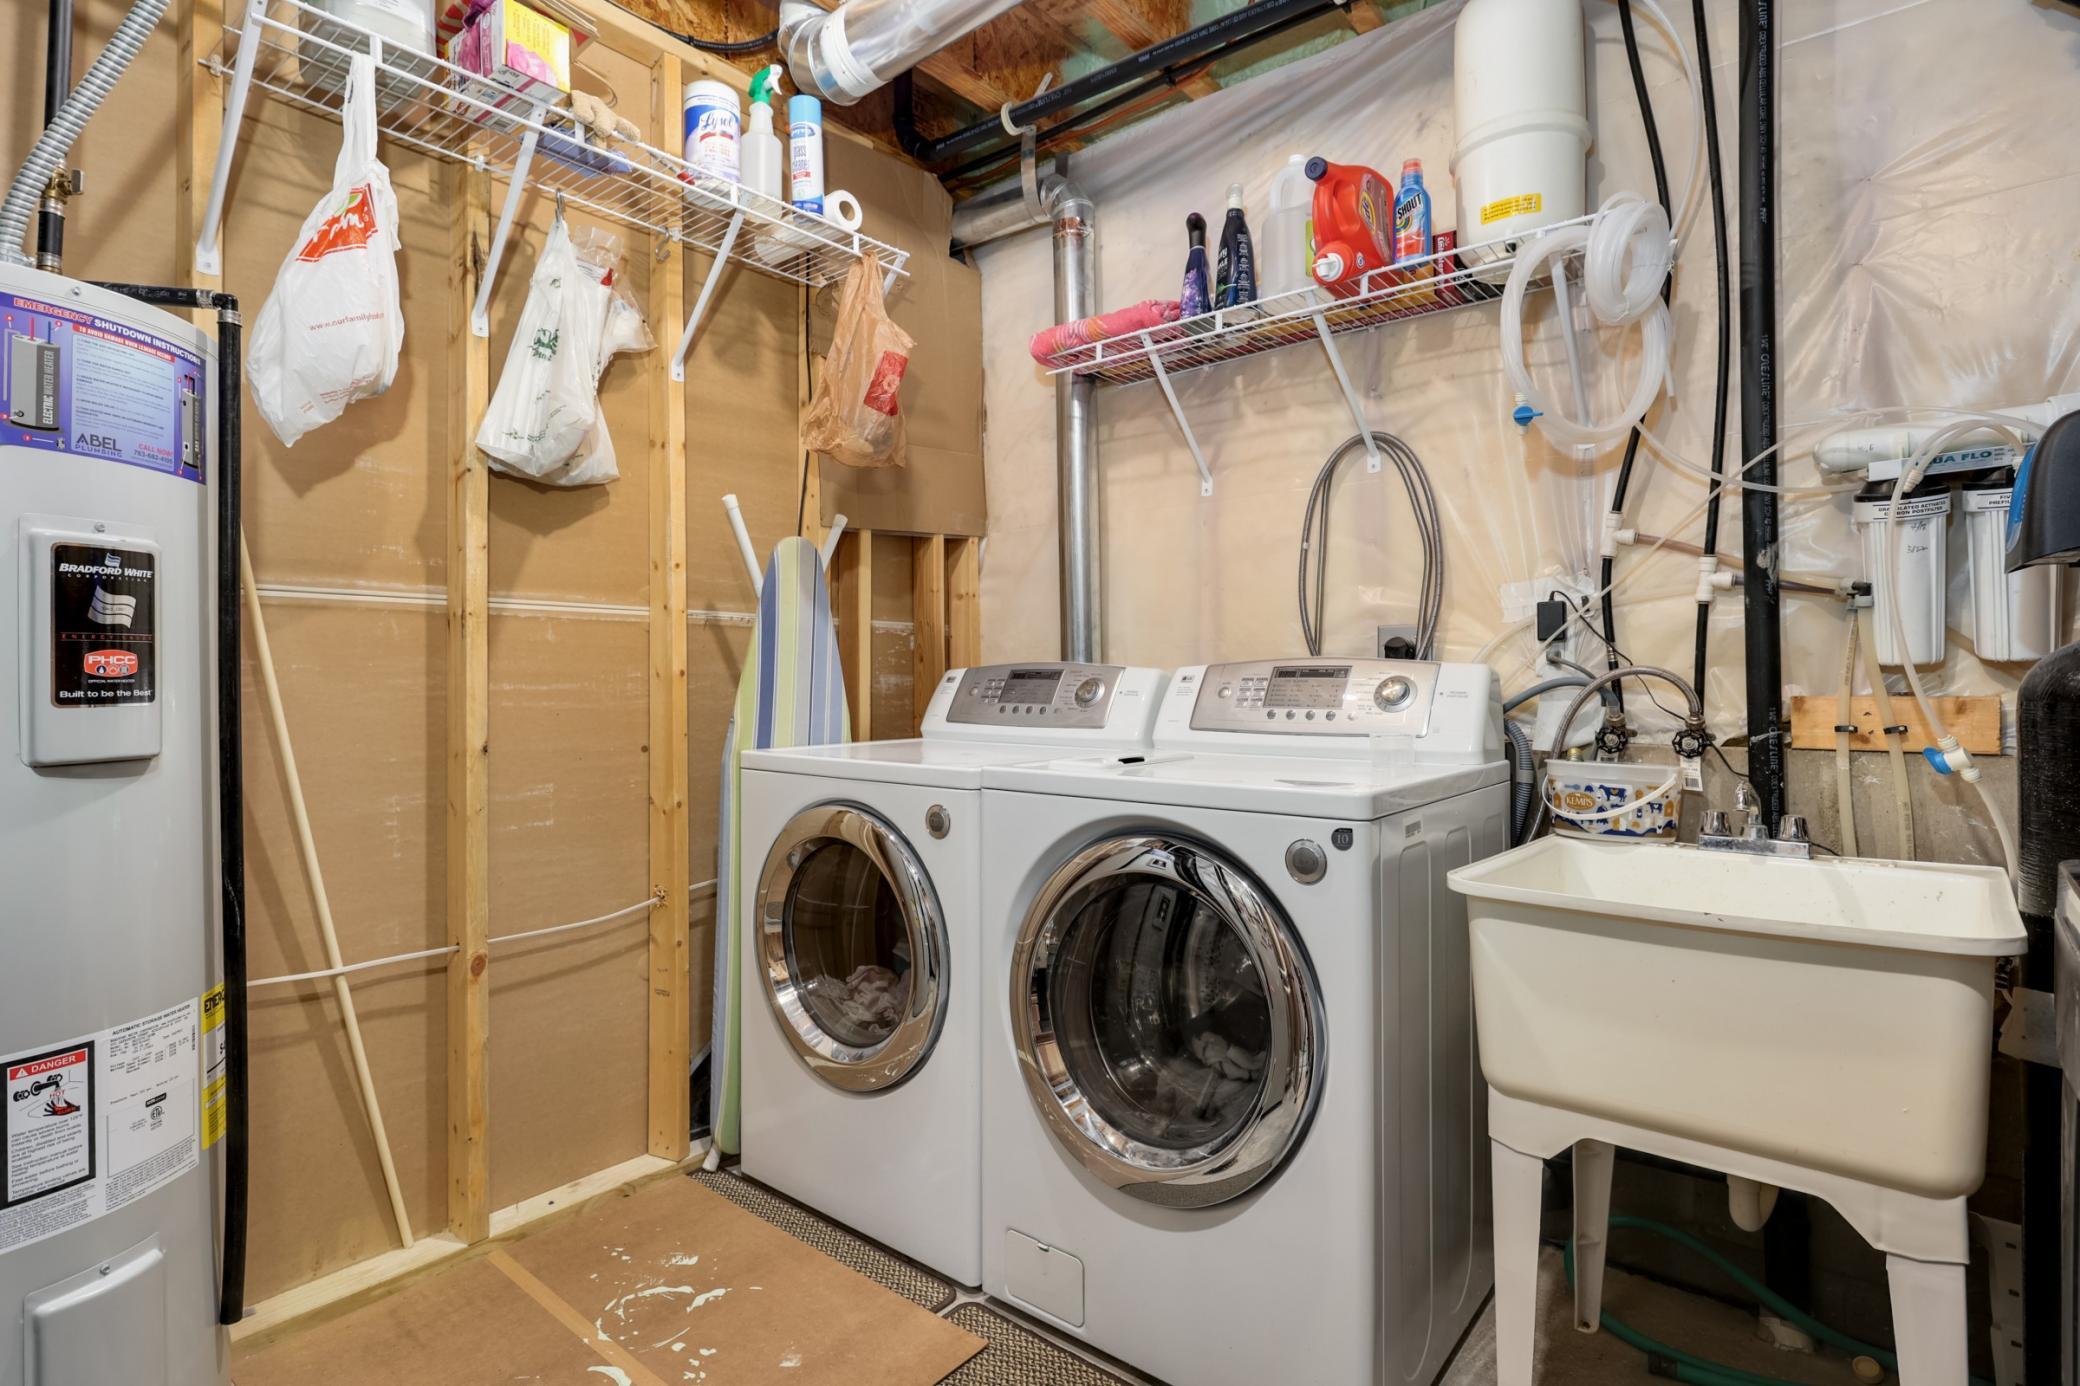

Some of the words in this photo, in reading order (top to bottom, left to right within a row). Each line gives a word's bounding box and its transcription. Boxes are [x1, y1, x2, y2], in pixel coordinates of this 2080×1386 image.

[1397, 192, 1422, 219] SHOUT
[14, 299, 93, 323] EMERGENCY
[95, 318, 152, 343] SHUTDOWN
[43, 395, 54, 425] ELECTRIC
[76, 433, 122, 452] ABEL
[74, 443, 122, 457] PLUMBING
[1961, 450, 1992, 461] FLO
[59, 563, 122, 575] BRADFORD
[124, 568, 153, 578] WHITE
[88, 655, 136, 664] PHCC
[87, 690, 98, 698] to
[101, 689, 114, 697] be
[1566, 796, 1593, 807] KEMPS
[1336, 834, 1349, 844] 10
[31, 1055, 76, 1073] DANGER
